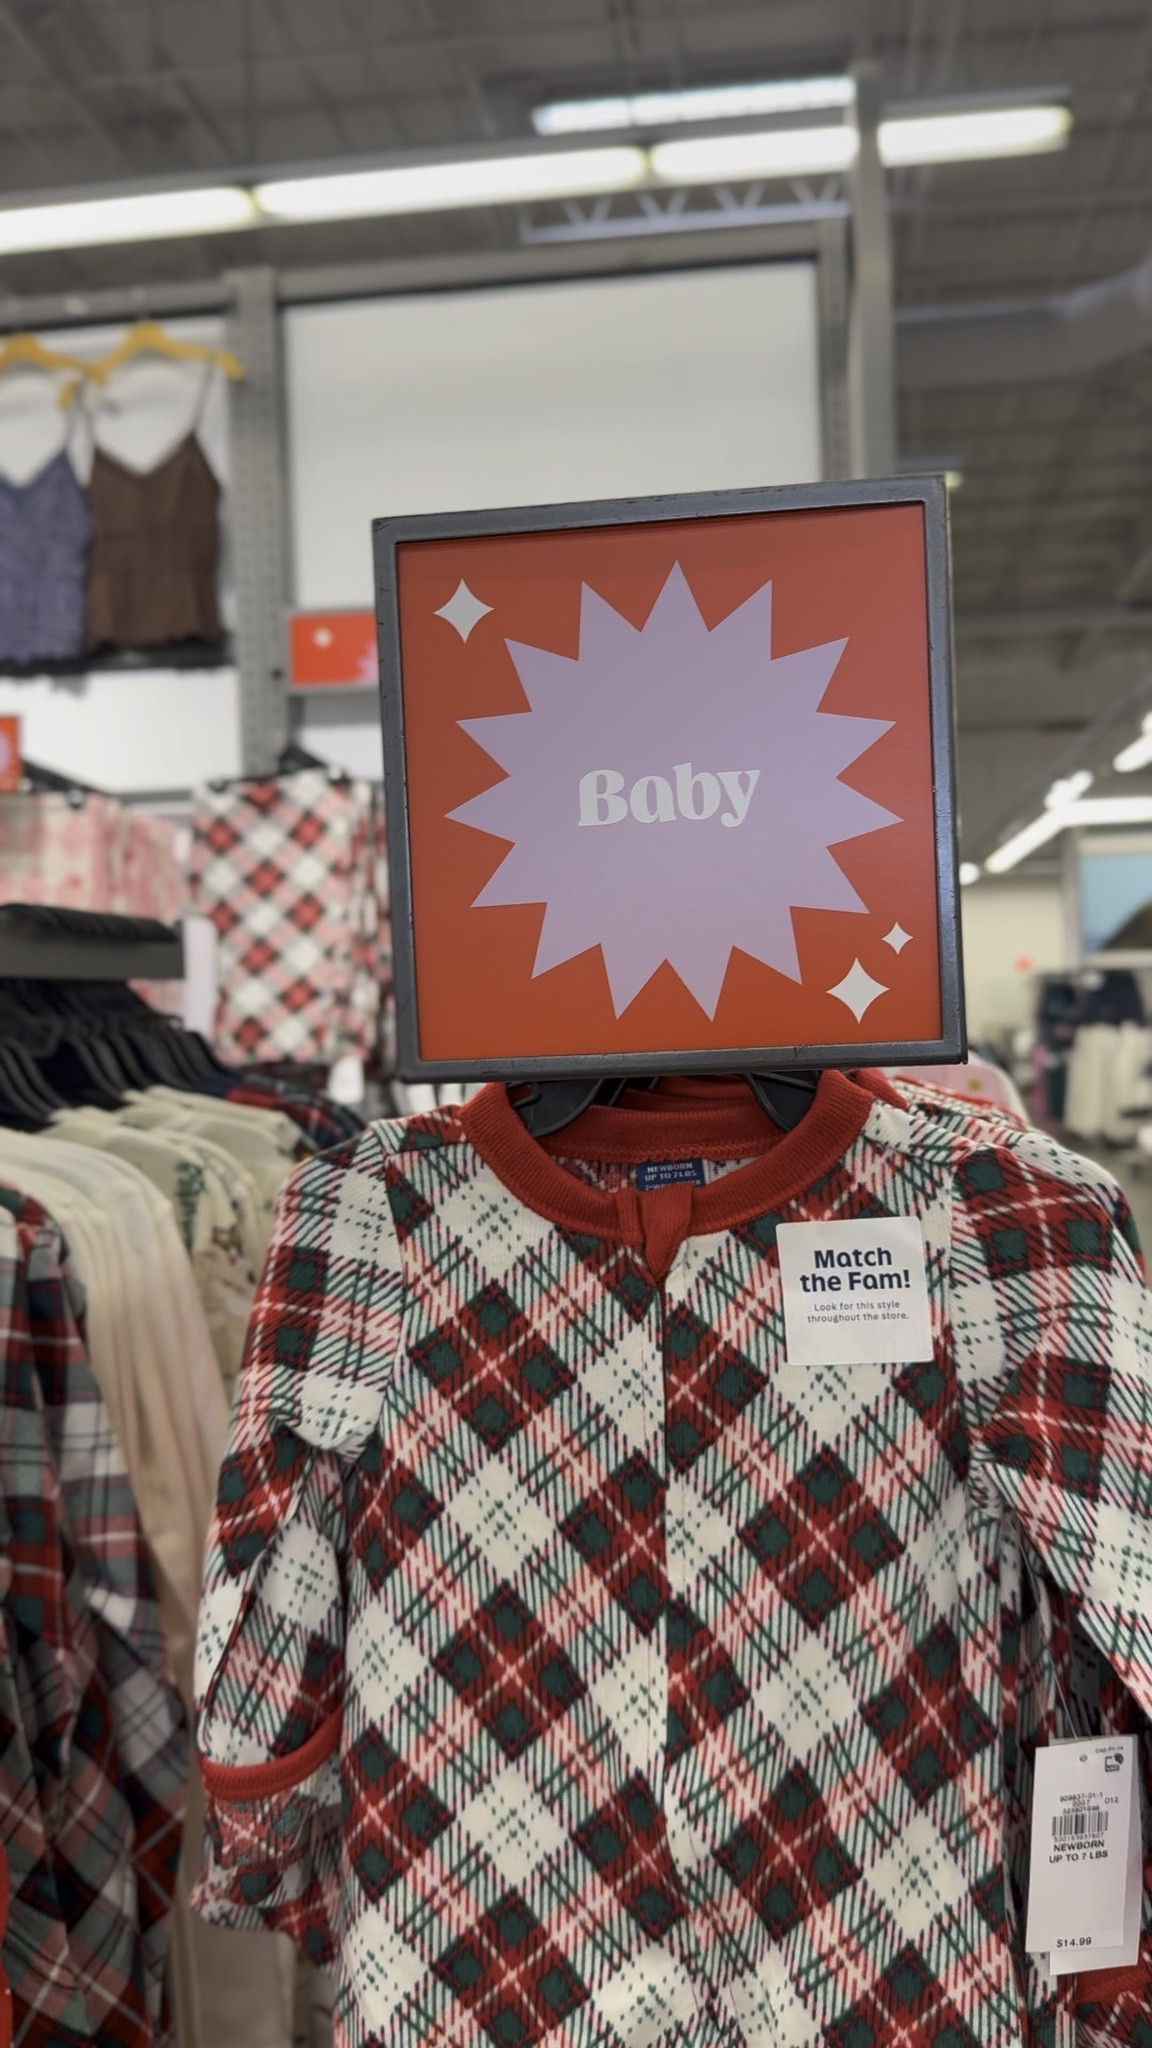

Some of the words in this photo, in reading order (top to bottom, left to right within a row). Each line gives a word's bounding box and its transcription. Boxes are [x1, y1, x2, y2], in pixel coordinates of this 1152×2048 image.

[577, 762, 762, 828] Baby
[647, 1162, 693, 1172] NEWBORN
[644, 1173, 657, 1181] UP
[814, 1247, 892, 1269] Match
[800, 1273, 842, 1293] the
[848, 1269, 911, 1291] Fam!
[814, 1302, 837, 1312] Look
[840, 1301, 853, 1311] for
[856, 1301, 875, 1310] this
[877, 1300, 900, 1311] style
[807, 1313, 860, 1324] throughout
[863, 1312, 879, 1321] the
[881, 1311, 909, 1320] store.
[1053, 1839, 1105, 1852] NEWBORN
[1049, 1854, 1063, 1863] UP
[1066, 1853, 1079, 1862] TO
[1081, 1852, 1087, 1860] 7
[1089, 1849, 1109, 1860] LBS
[1056, 1936, 1092, 1948] $14.99
